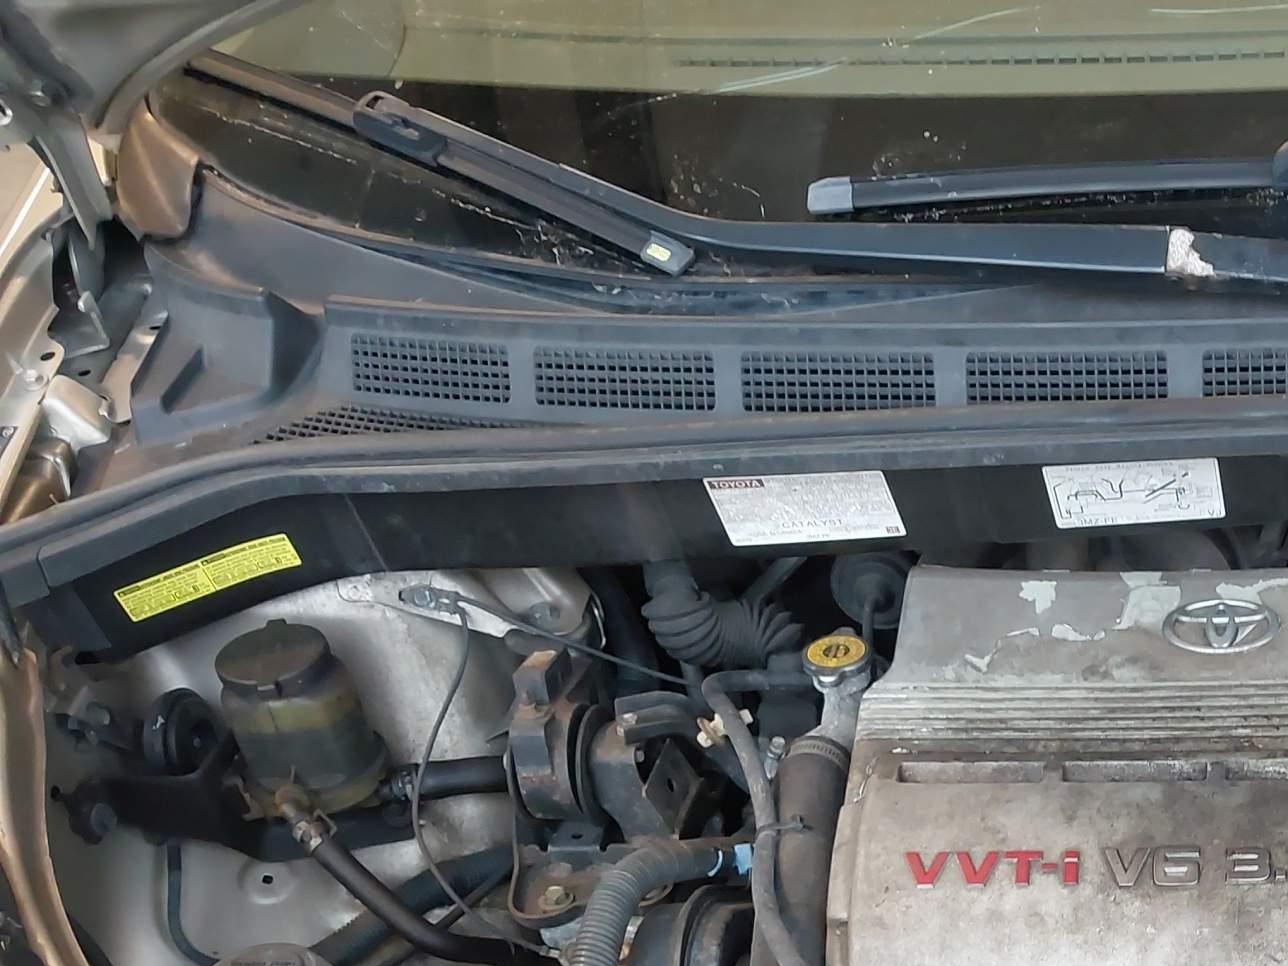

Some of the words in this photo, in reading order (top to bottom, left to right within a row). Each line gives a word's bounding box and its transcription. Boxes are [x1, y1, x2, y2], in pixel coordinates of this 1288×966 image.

[711, 480, 762, 489] TOYOTA
[781, 519, 844, 530] CATALYST
[904, 849, 1081, 888] VVT-i
[1102, 845, 1202, 887] V6
